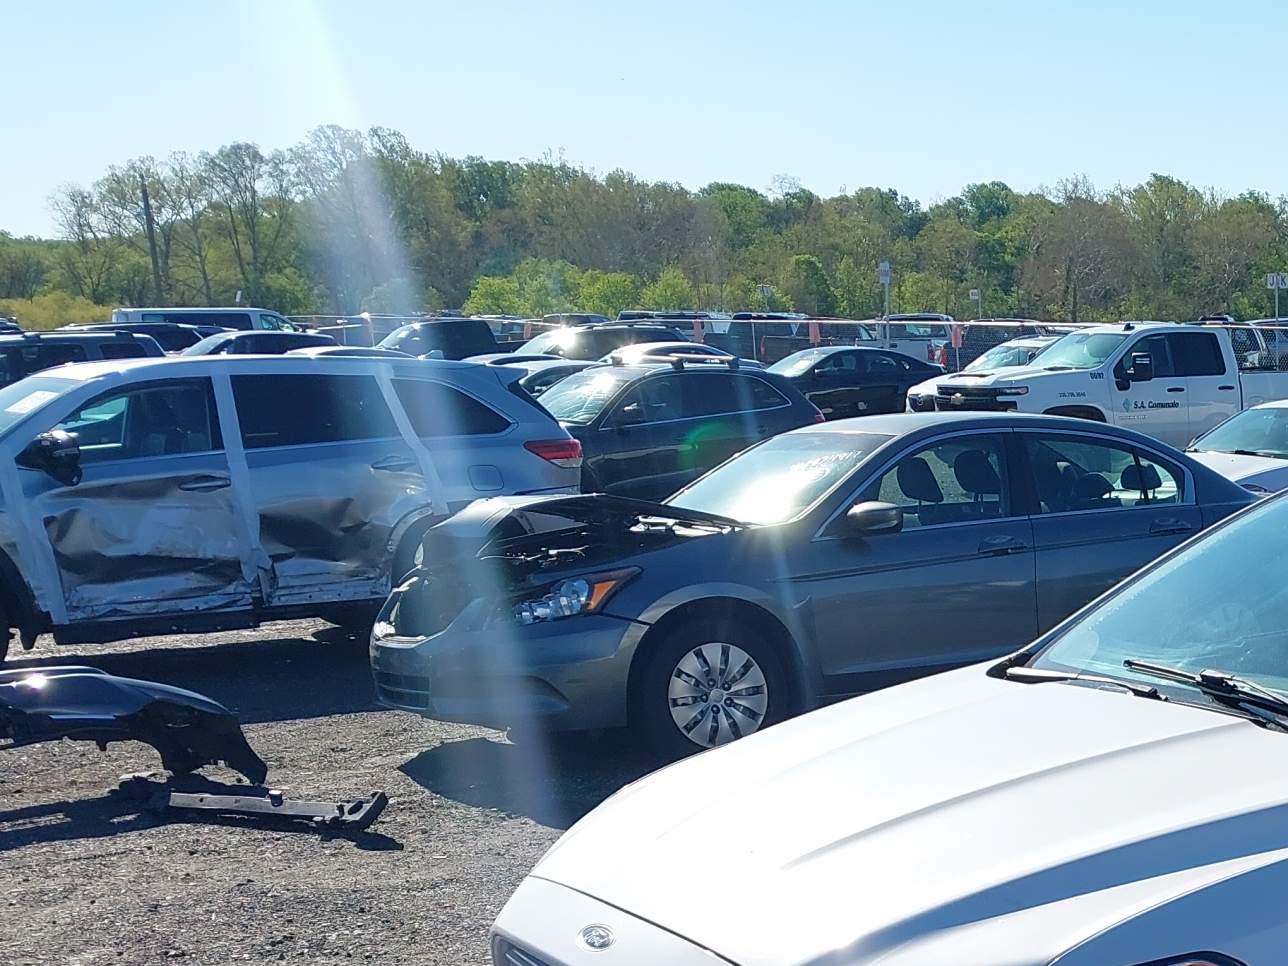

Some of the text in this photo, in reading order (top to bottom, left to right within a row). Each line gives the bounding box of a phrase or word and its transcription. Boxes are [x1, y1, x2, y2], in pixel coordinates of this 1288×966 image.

[1269, 275, 1287, 287] J K
[1133, 400, 1147, 409] S.A.
